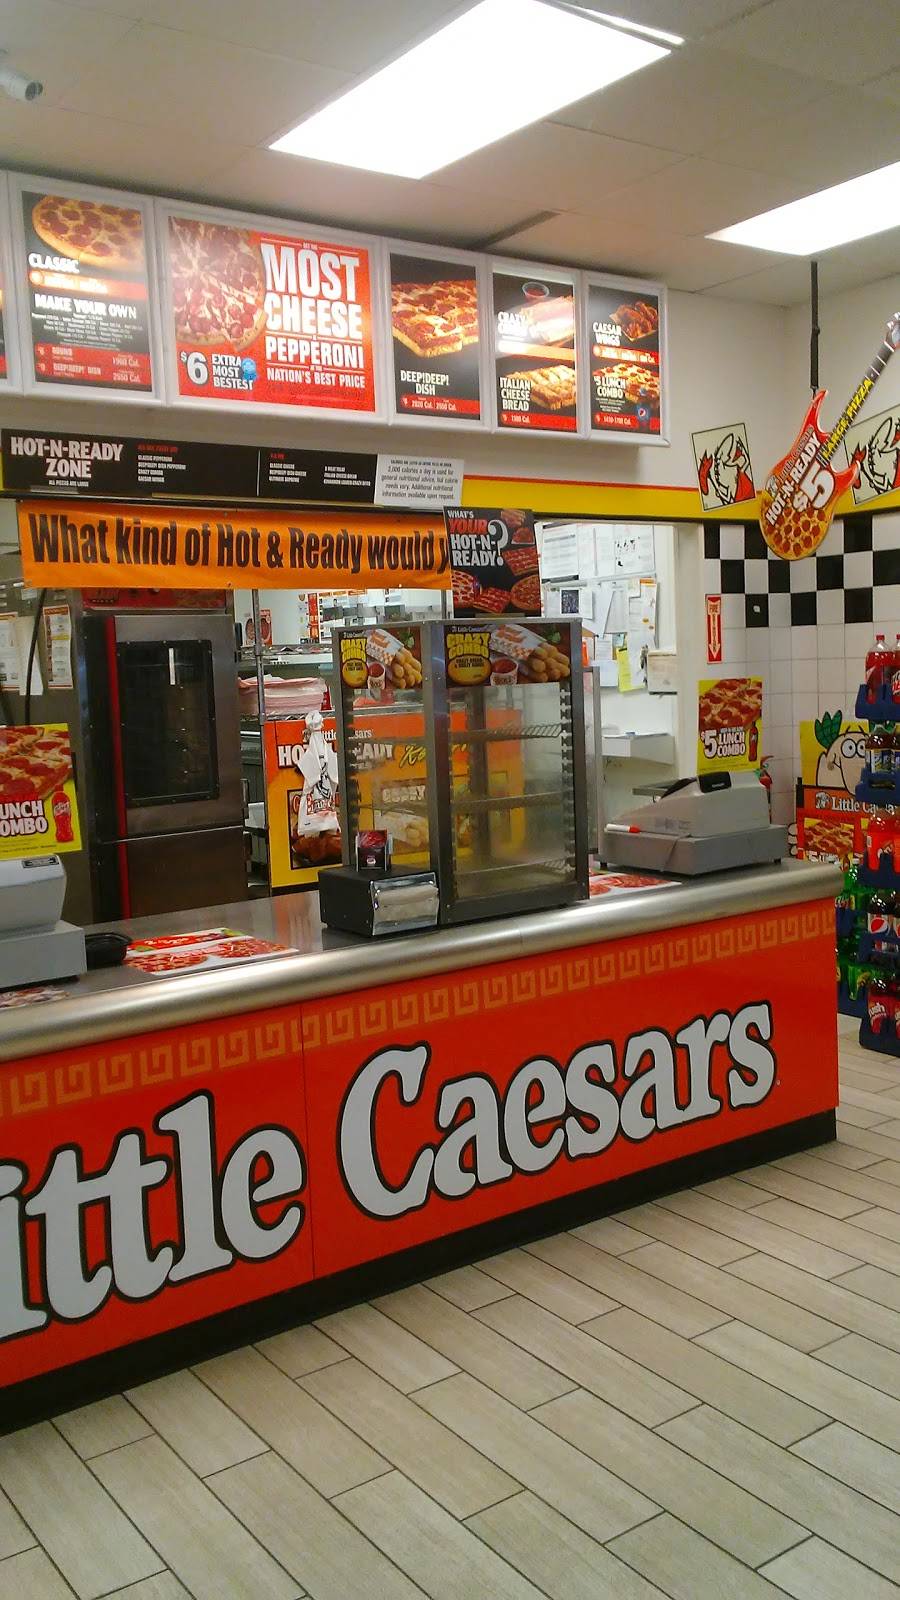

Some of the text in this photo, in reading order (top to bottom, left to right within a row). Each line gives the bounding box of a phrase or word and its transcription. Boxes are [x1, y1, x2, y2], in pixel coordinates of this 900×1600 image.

[260, 243, 359, 303] MOST
[34, 293, 73, 312] MAKE
[108, 303, 137, 319] OWN
[264, 292, 363, 342] CHEESE
[593, 322, 622, 337] CAESAR
[212, 353, 242, 367] EXTRA
[265, 336, 364, 369] PEPPERONI
[181, 351, 208, 386] $6
[212, 365, 240, 379] MOST
[213, 376, 254, 391] BESTEST
[267, 368, 366, 389] NATION'S BEST PRICE
[500, 376, 532, 392] ITALIAN
[601, 377, 627, 390] LUNCH
[415, 382, 436, 396] DISH
[501, 388, 531, 401] CHEESE
[597, 387, 624, 399] COMBO
[502, 399, 530, 412] BREAD
[846, 378, 875, 419] PIZZA
[10, 436, 124, 461] HOT-N-READY
[46, 458, 92, 479] ZONE
[388, 466, 401, 474] 2,000
[765, 432, 821, 527] HOT-N-READY
[791, 460, 835, 513] $5
[447, 510, 475, 519] WHAT'S
[449, 518, 489, 535] YOUR
[28, 513, 111, 566] What
[115, 518, 178, 567] kind
[184, 523, 212, 567] of
[217, 523, 261, 569] Hot
[265, 531, 284, 569] &
[288, 527, 363, 575] Ready
[367, 530, 437, 571] would
[450, 533, 496, 551] HOT-N-
[446, 632, 491, 649] CRAZY
[448, 642, 490, 660] COMBO
[701, 729, 718, 758] $5
[719, 731, 745, 745] LUNCH
[717, 743, 746, 757] COMBO
[0, 799, 44, 821] UNCH
[831, 796, 861, 813] Little
[0, 816, 49, 837] OMBO
[0, 1001, 775, 1341] ittle Caesars
